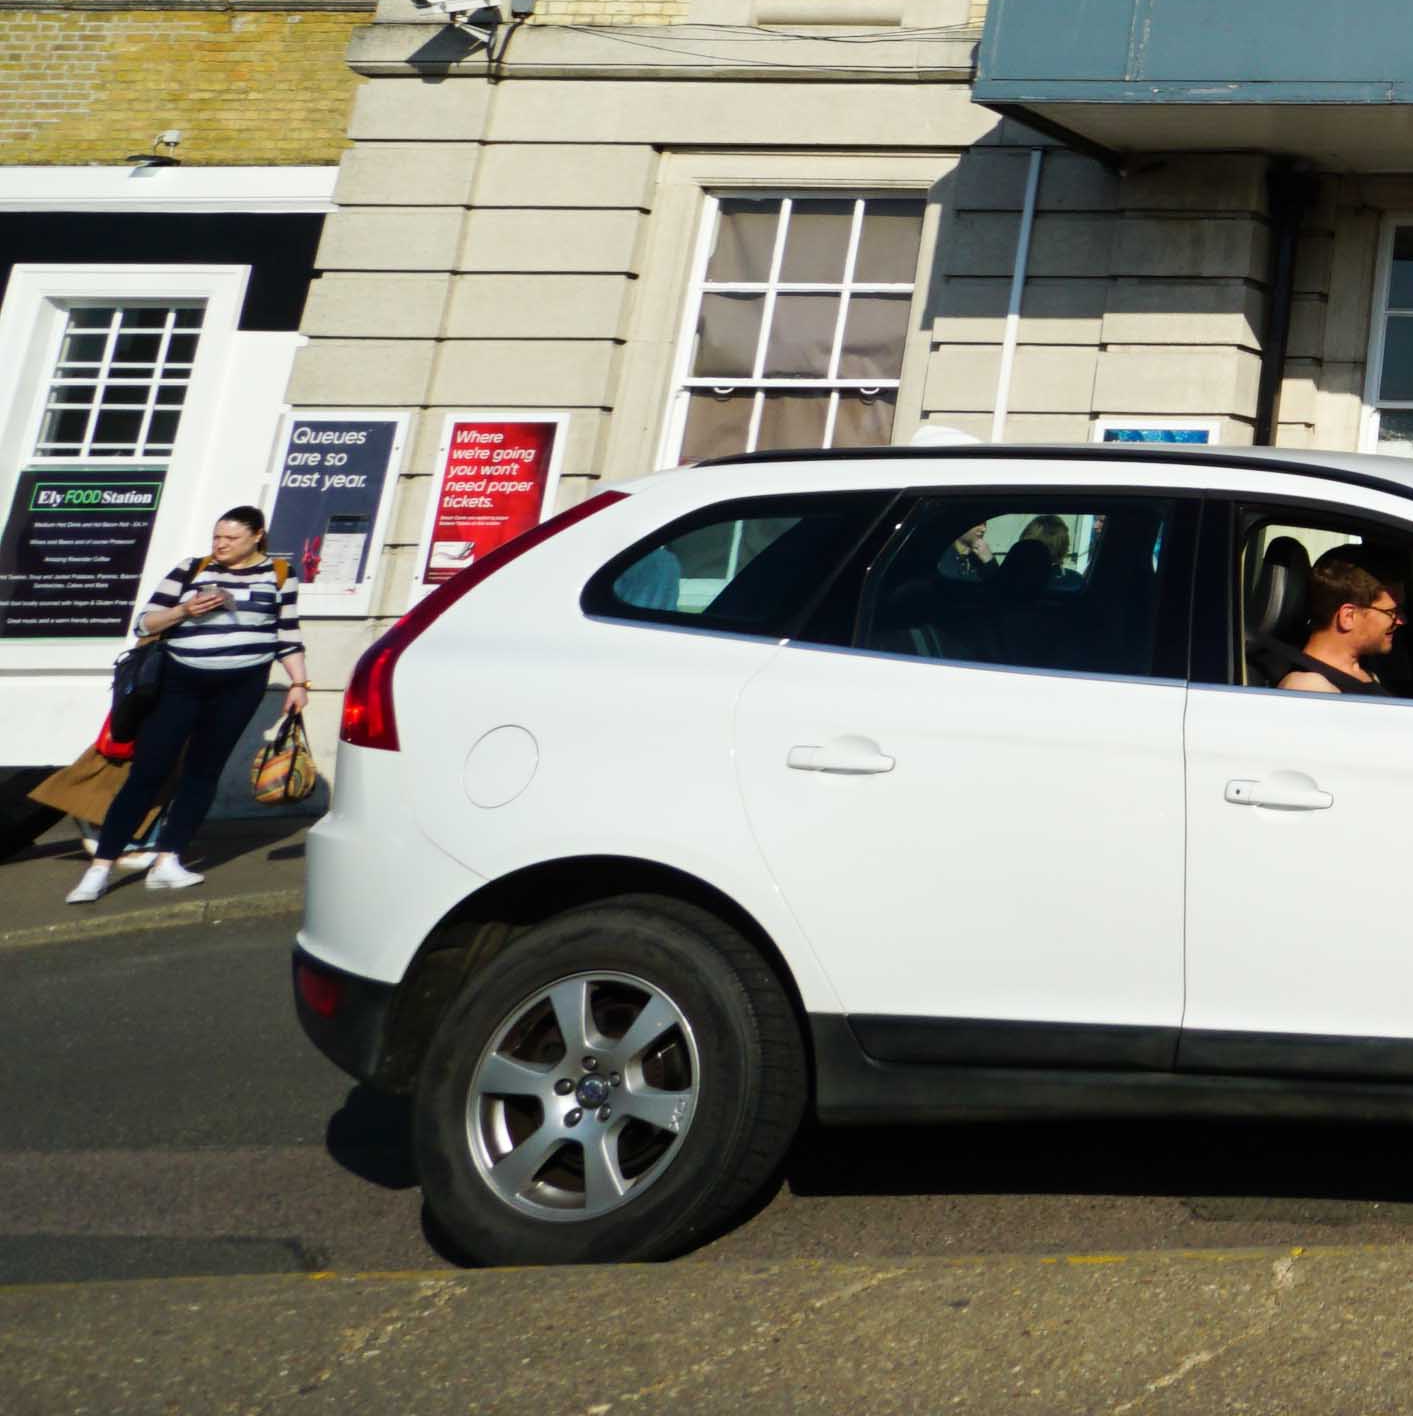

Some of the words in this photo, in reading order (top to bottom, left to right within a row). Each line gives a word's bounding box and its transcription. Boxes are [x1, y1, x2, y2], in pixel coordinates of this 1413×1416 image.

[293, 427, 367, 444] Queues
[456, 430, 504, 444] Where
[288, 452, 321, 466] are
[324, 452, 347, 466] so
[452, 447, 490, 460] we're
[492, 447, 536, 462] going
[448, 465, 477, 478] you
[480, 462, 520, 475] won't
[281, 470, 320, 487] last
[321, 474, 368, 492] year.
[445, 479, 487, 492] need
[487, 481, 534, 494] paper
[37, 490, 65, 507] Ely
[64, 489, 102, 504] FOOD
[101, 490, 153, 504] Station
[442, 495, 494, 508] tickets.
